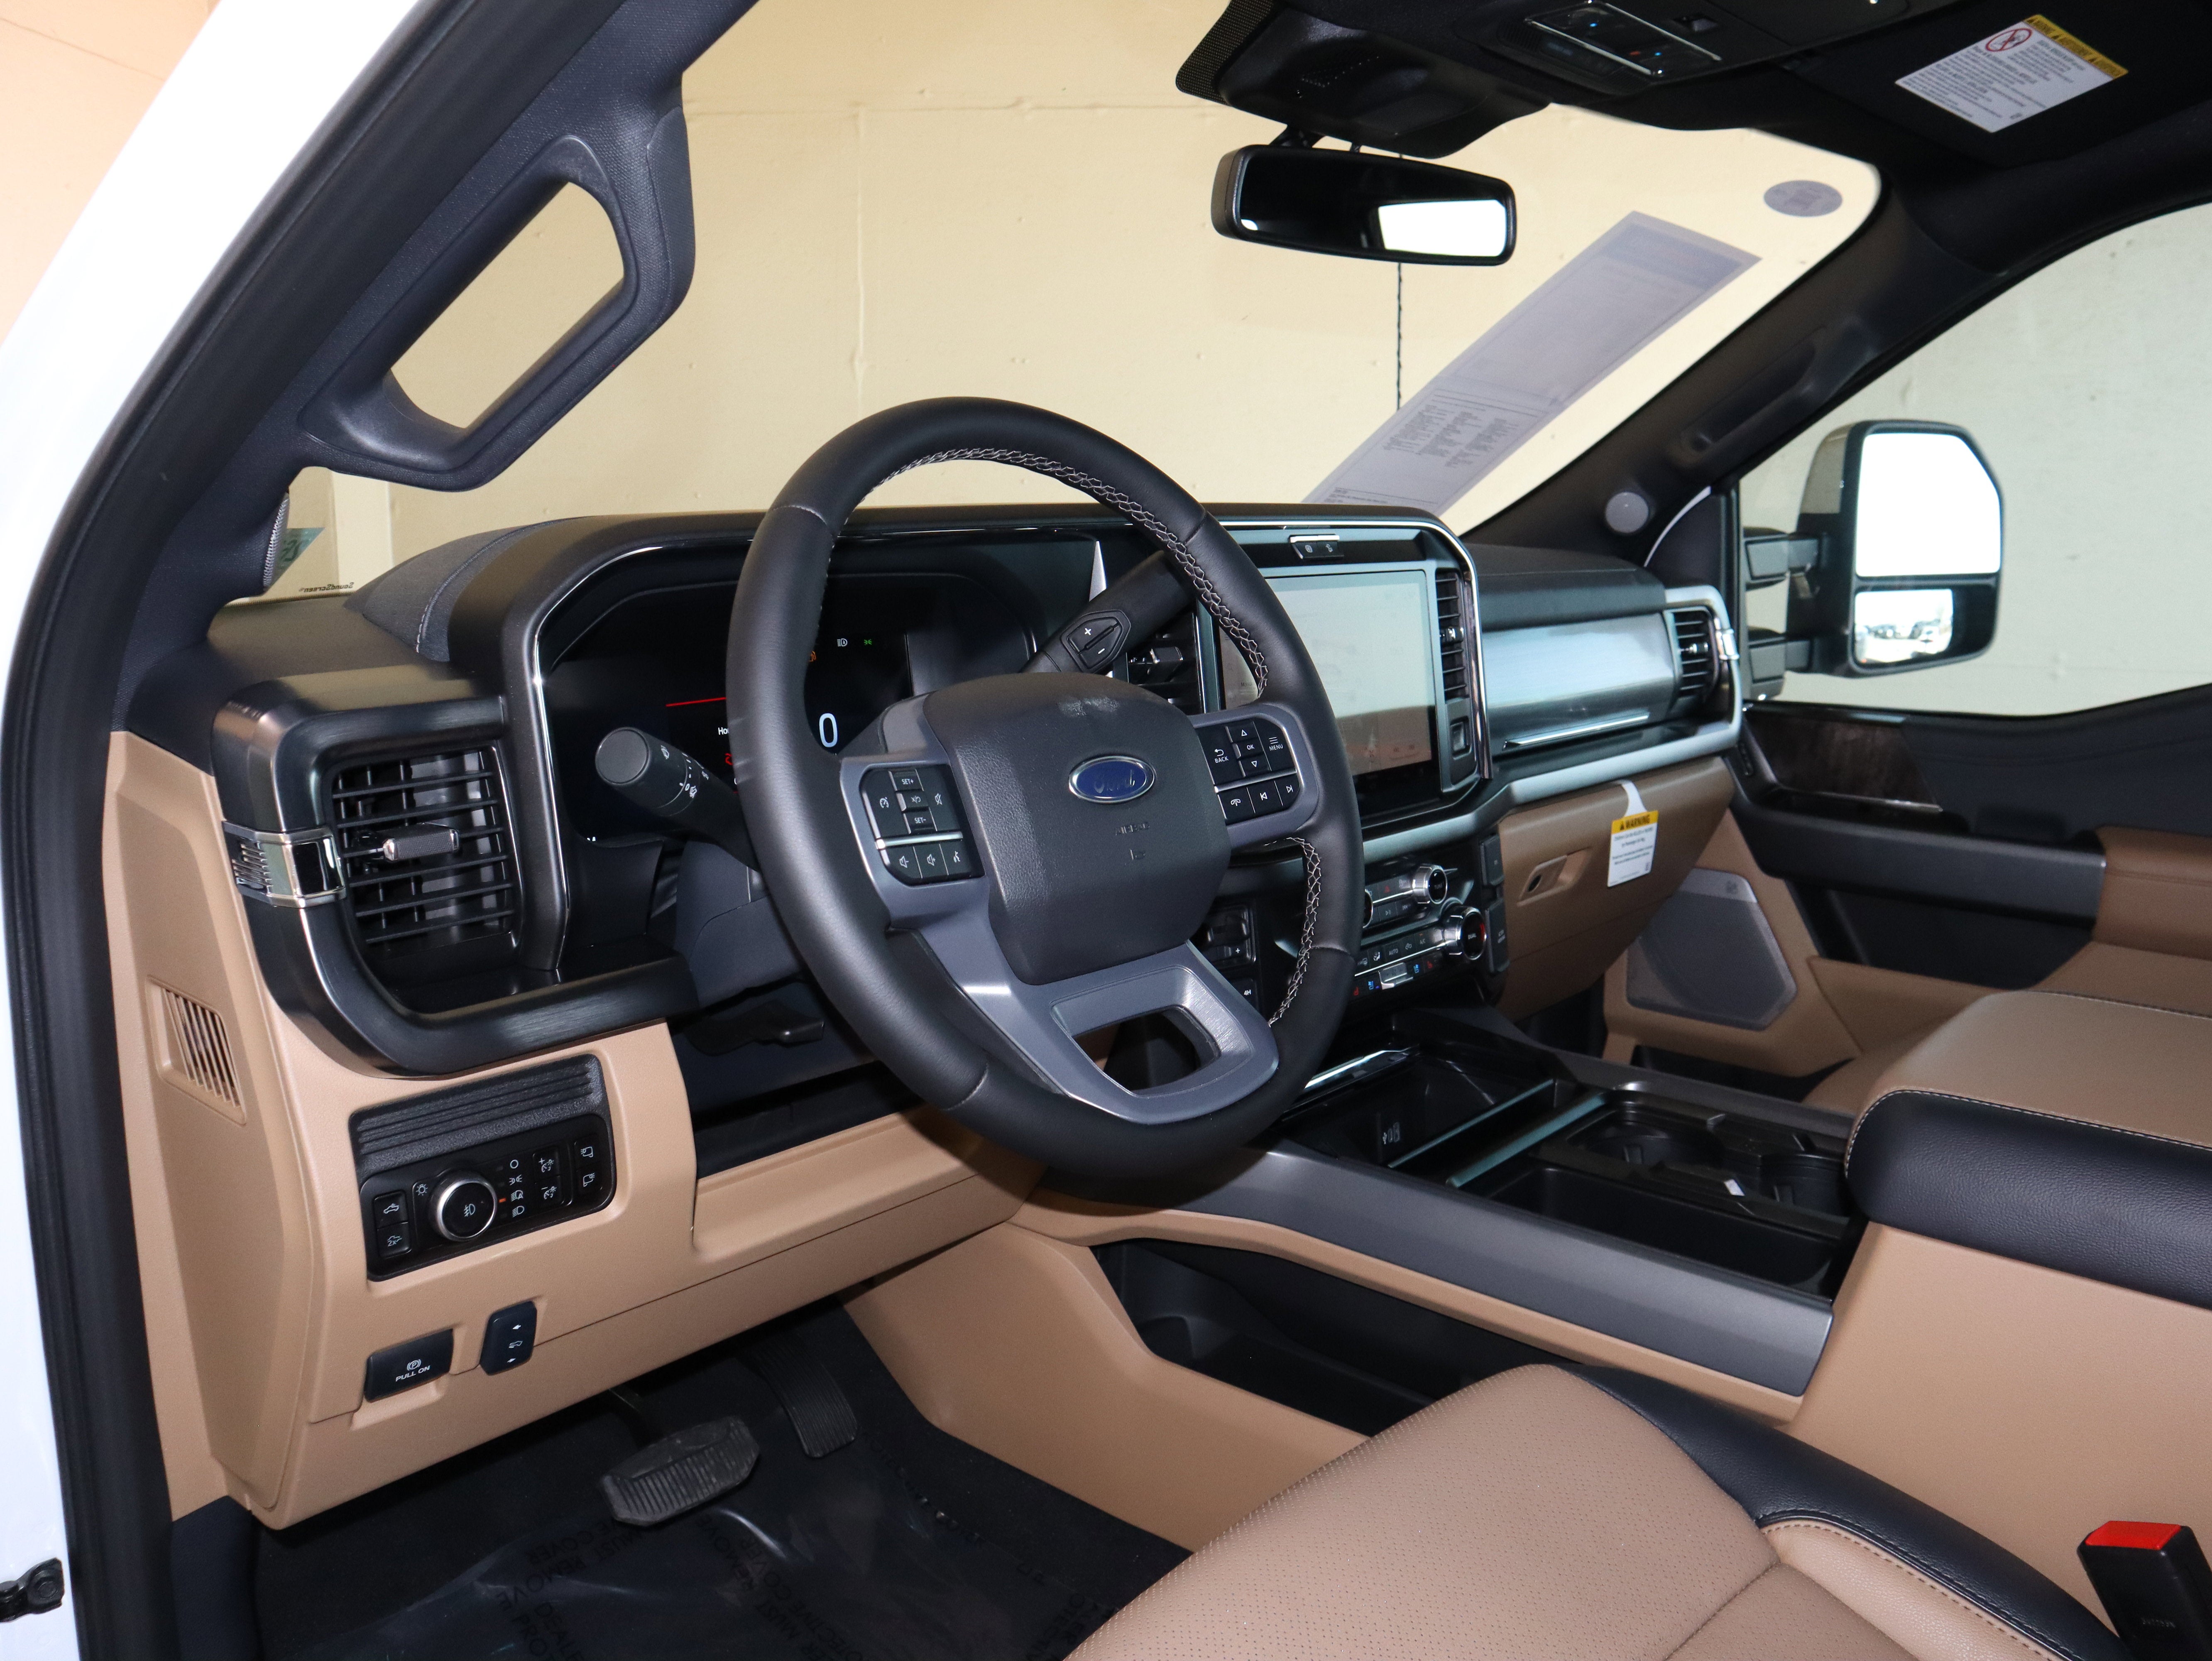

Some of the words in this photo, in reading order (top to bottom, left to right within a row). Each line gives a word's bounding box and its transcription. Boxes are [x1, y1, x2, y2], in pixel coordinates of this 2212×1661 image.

[819, 713, 838, 748] 0
[395, 1372, 416, 1382] PULL
[418, 1365, 431, 1374] ON
